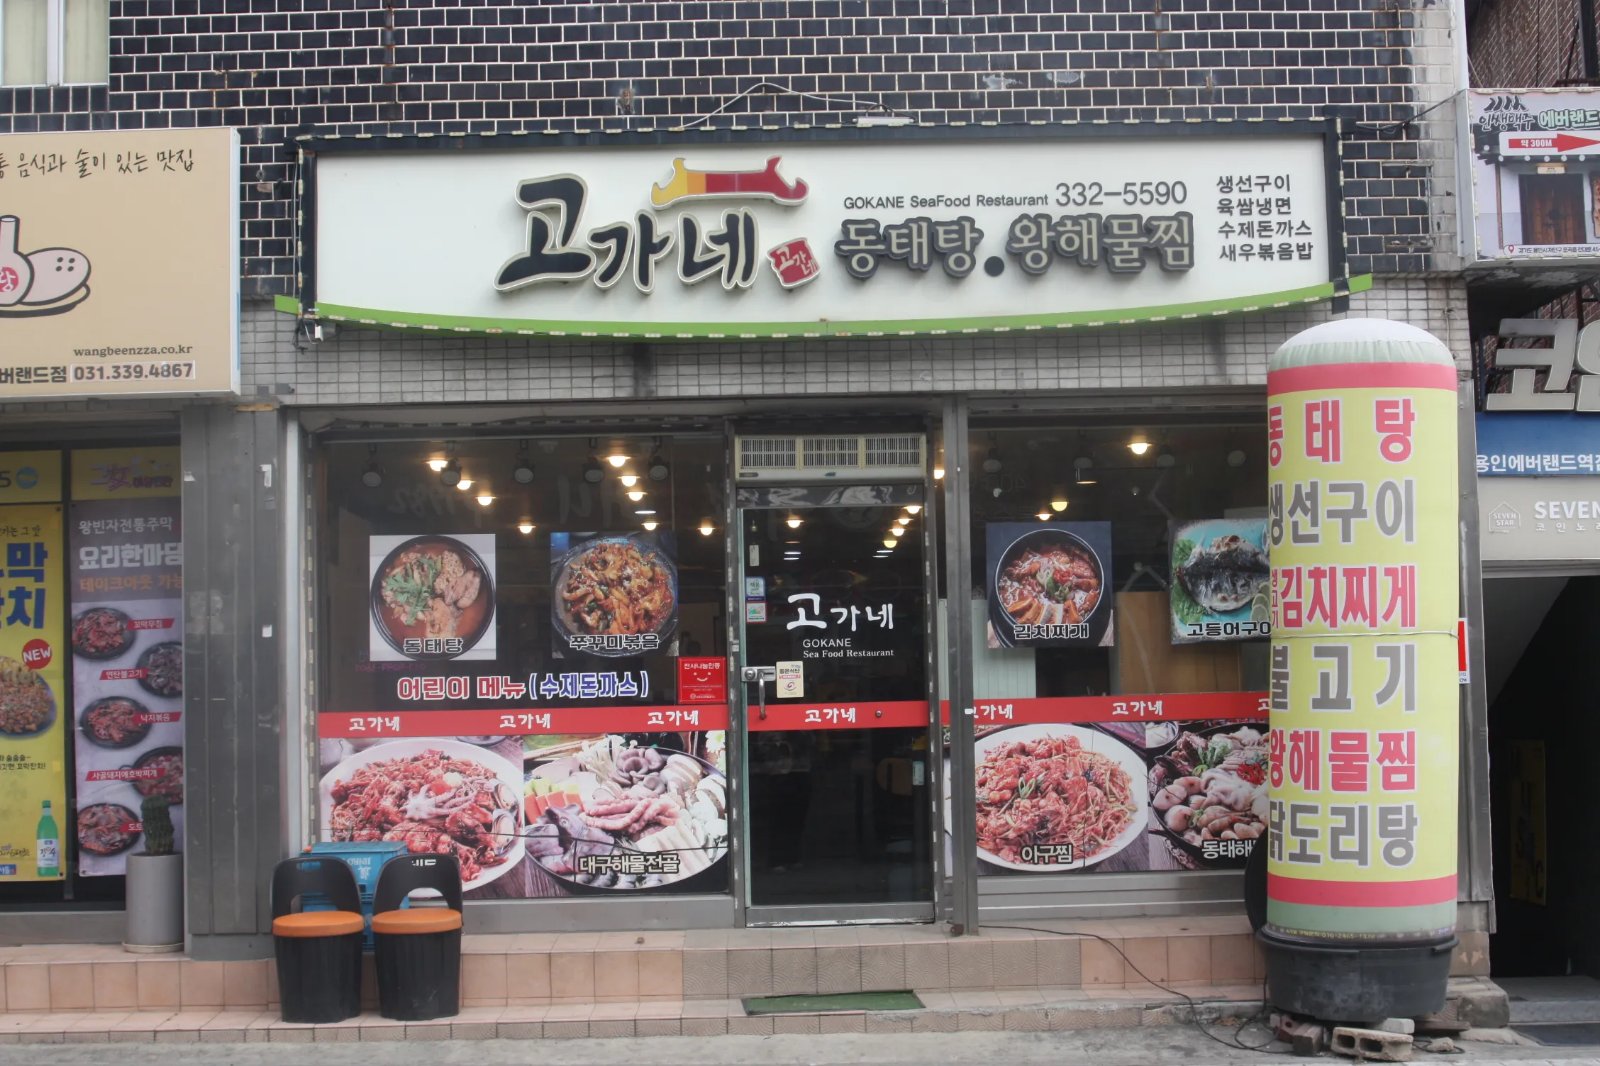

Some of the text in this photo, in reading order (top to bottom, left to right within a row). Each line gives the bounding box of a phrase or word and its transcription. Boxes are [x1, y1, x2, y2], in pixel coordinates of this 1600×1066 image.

[1479, 111, 1535, 131] 인생맥주
[1540, 109, 1600, 129] 에버랜드
[1530, 139, 1552, 147] 300M
[17, 154, 67, 177] 음식과
[75, 149, 106, 178] 술이
[117, 152, 149, 174] 있는
[157, 149, 194, 172] 맛집
[1216, 174, 1292, 193] 생선구이
[844, 181, 1188, 209] GOKANE SeaFood Restaurant 332-5590
[1216, 196, 1293, 215] 육쌈냉면
[494, 172, 760, 296] 고가네
[1218, 219, 1313, 239] 수제돈까스
[776, 246, 817, 276] 고가네
[1219, 241, 1314, 262] 새우볶음밥
[73, 344, 193, 358] wangbeenzza.co.kr
[74, 363, 194, 381] 031.339.4867
[1269, 399, 1416, 467] 동태탕
[1270, 479, 1414, 546] 생선구이
[1281, 566, 1416, 629] 김치찌게
[786, 593, 894, 632] 고가네
[403, 638, 463, 653] 동태탕
[570, 635, 660, 649] 쭈꾸미볶음
[803, 638, 852, 648] GOKANE
[22, 645, 51, 662] NEW
[803, 649, 894, 659] Sea Food Restaurant
[397, 676, 470, 700] 어린이
[1271, 645, 1415, 712] 불고기
[647, 710, 699, 726] 고가네
[805, 707, 856, 724] 고가네
[1112, 700, 1163, 716] 고가네
[349, 716, 400, 731] 고가네
[499, 713, 551, 729] 고가네
[1270, 729, 1415, 792] 왕해물찜
[1270, 801, 1418, 867] 닭도리탕
[579, 853, 681, 875] 대구해물전골
[1021, 844, 1073, 864] 아구찜
